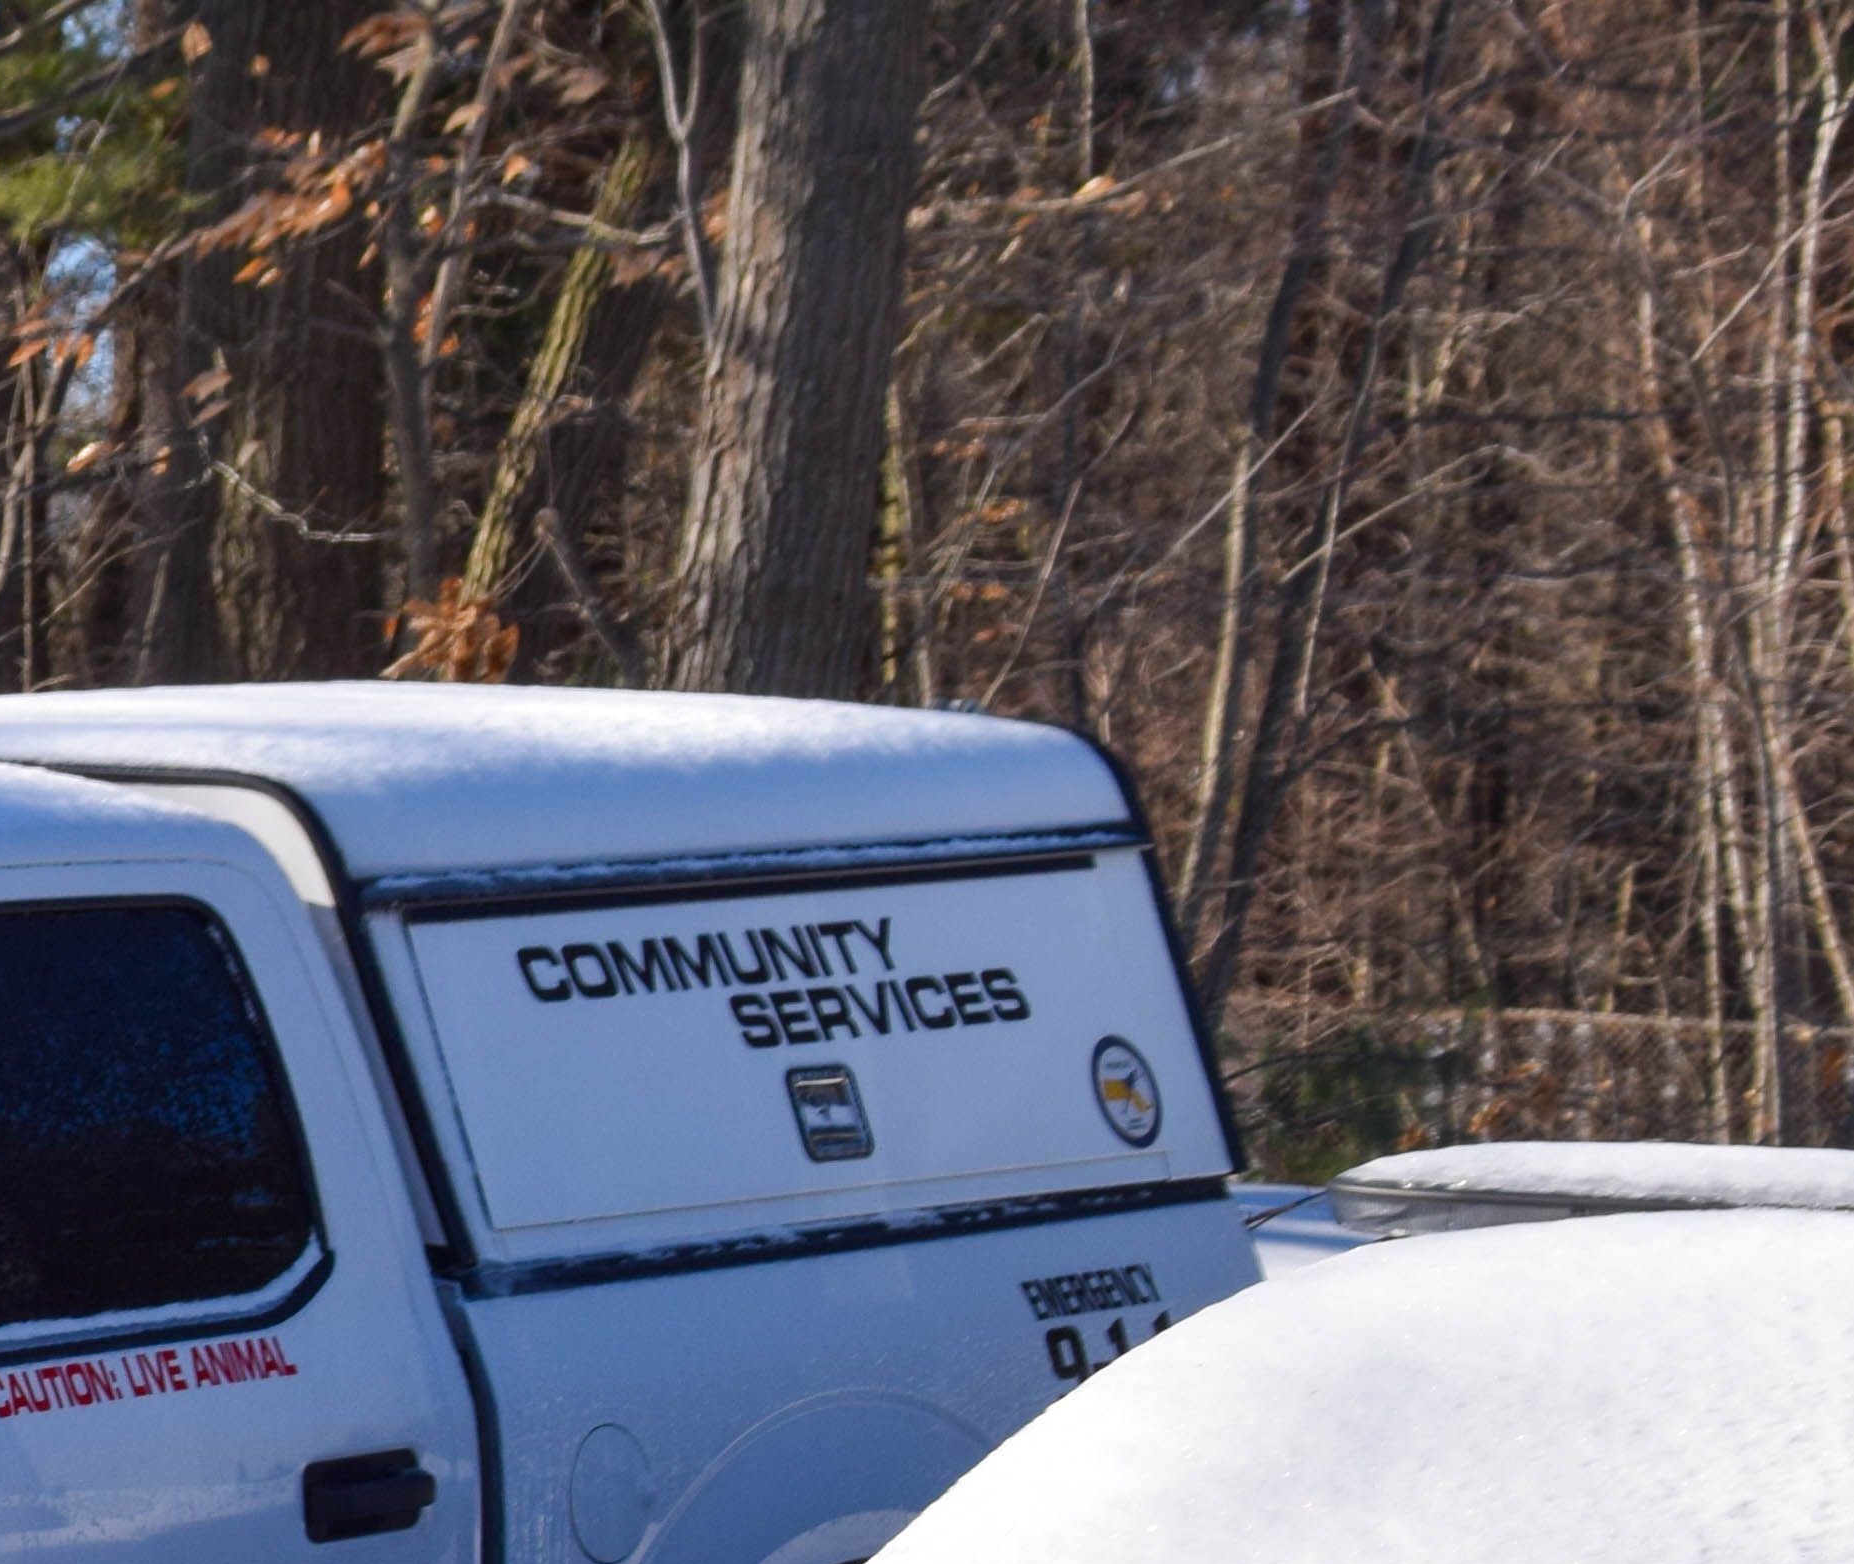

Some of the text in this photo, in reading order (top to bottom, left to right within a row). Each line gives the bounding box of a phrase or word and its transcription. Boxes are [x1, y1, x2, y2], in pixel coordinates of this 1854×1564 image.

[516, 917, 894, 1001] COMMUNITY
[729, 967, 1031, 1050] SERVICES
[1021, 1262, 1161, 1321] EMERGENCY
[122, 1349, 189, 1398] LIVE
[190, 1335, 298, 1388] ANIMAL
